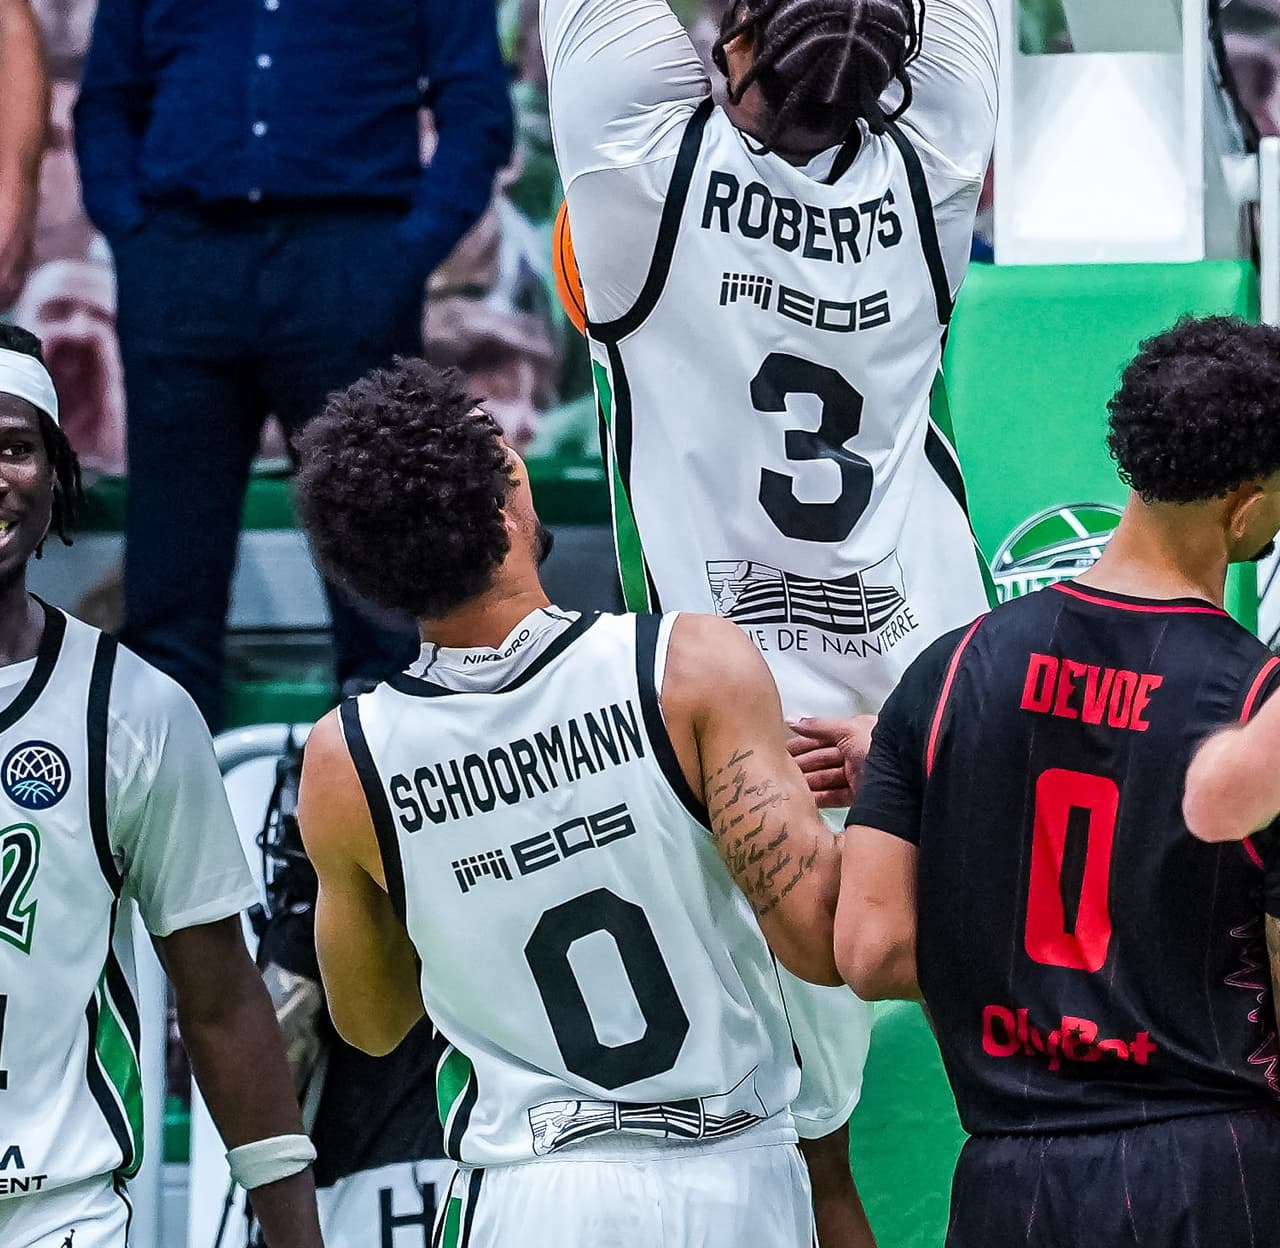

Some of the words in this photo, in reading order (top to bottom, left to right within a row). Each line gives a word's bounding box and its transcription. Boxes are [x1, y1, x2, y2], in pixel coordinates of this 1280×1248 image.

[700, 169, 903, 264] ROBERTS
[749, 352, 875, 544] 3
[777, 628, 808, 651] DE
[822, 607, 919, 658] NANTERRE
[1020, 653, 1164, 732] DEVOE
[389, 699, 646, 834] SCHOORMANN
[1024, 767, 1119, 973] 0
[523, 887, 690, 1090] 0
